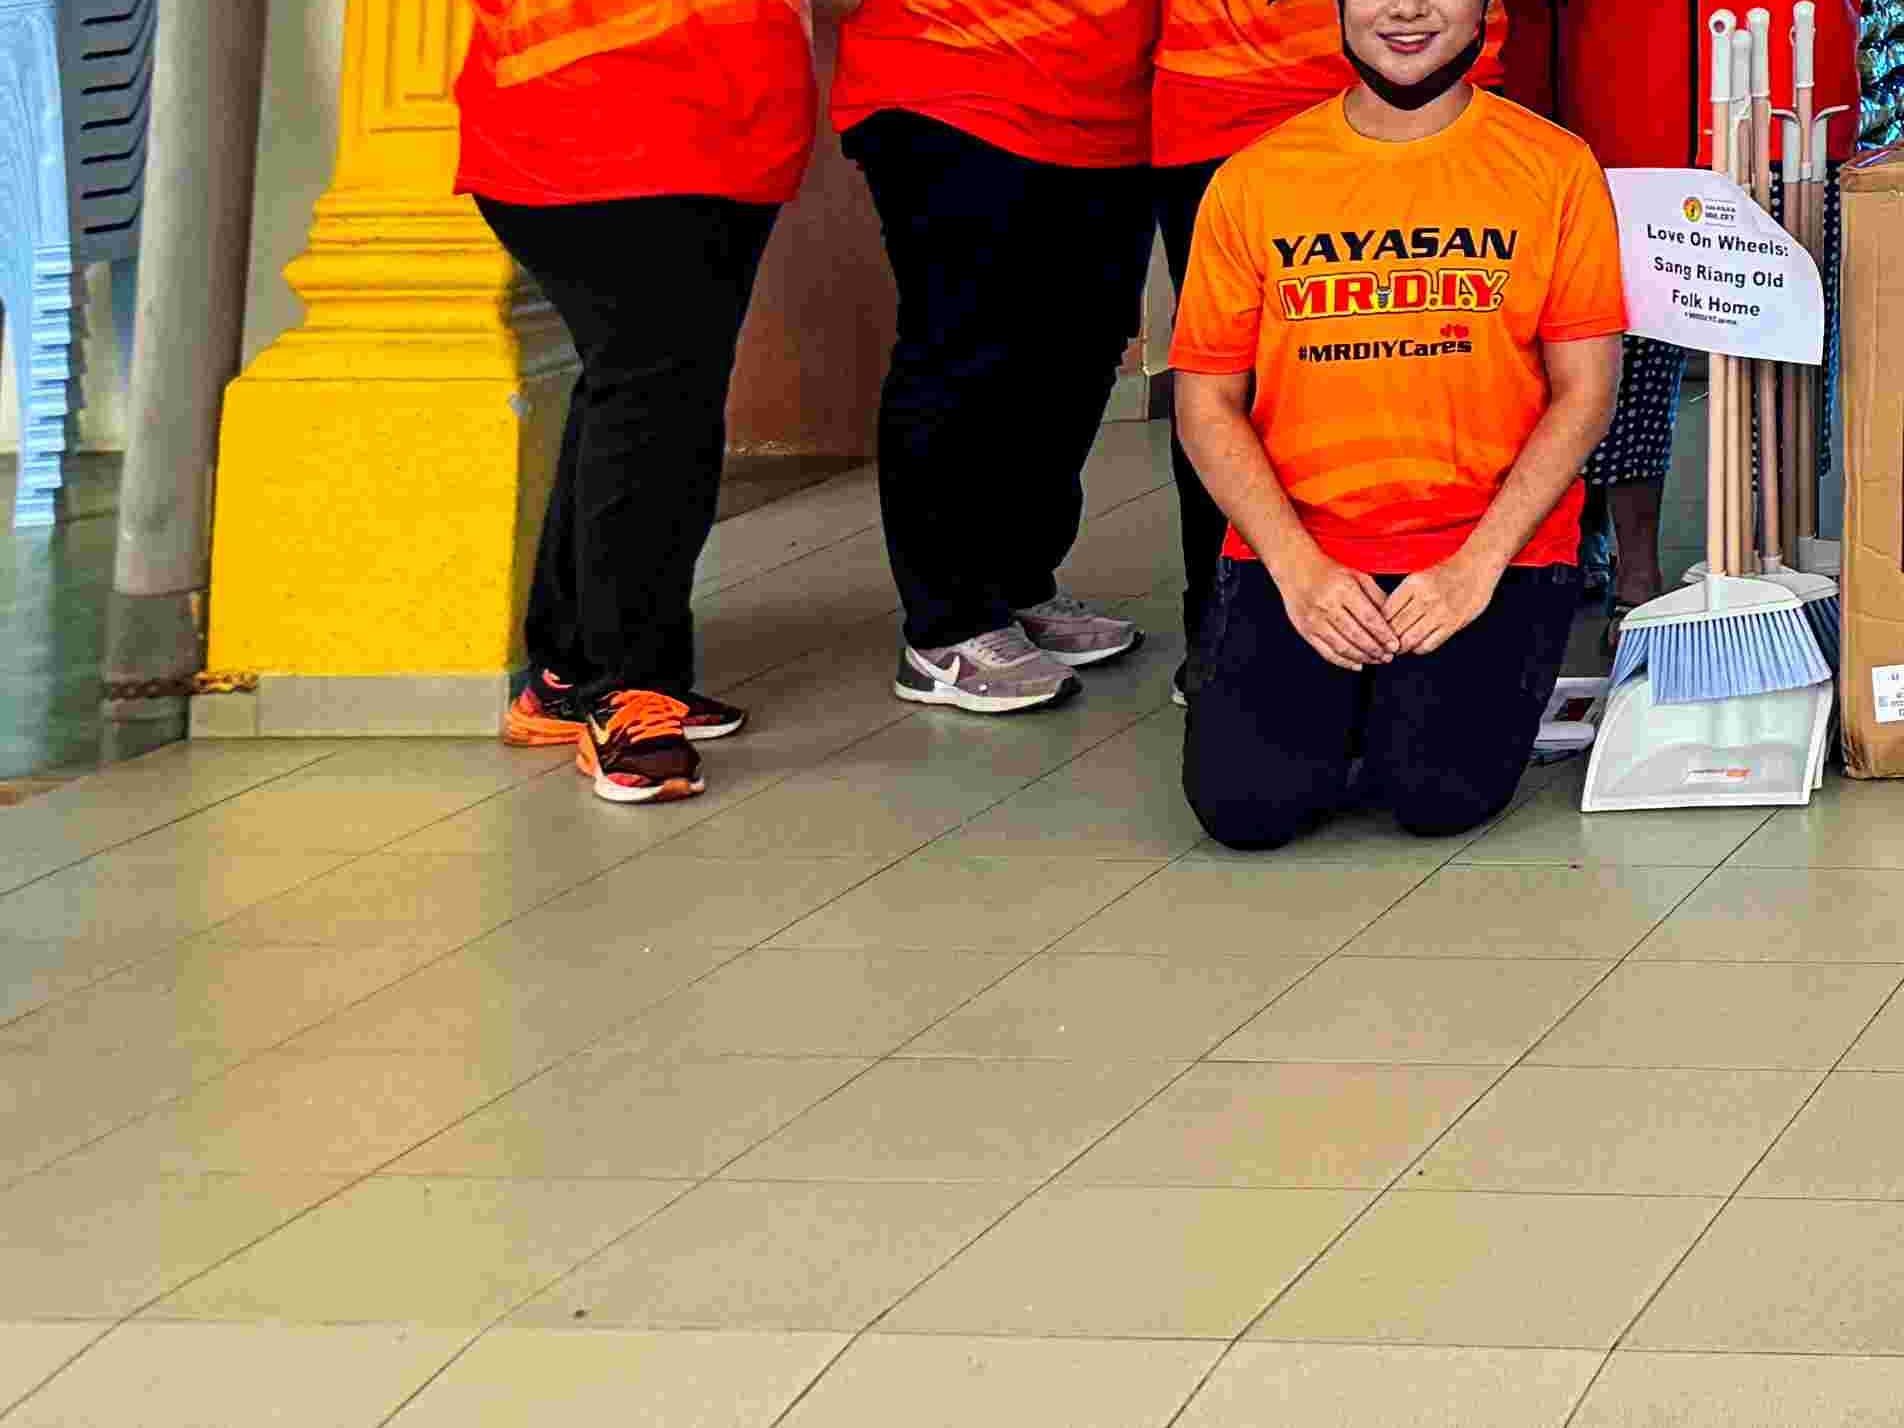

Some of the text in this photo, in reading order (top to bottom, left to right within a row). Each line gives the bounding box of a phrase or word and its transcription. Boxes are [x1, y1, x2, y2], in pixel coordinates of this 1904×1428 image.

[1273, 227, 1517, 268] YAYASAN
[1647, 224, 1789, 257] Love On Wheels:
[1654, 256, 1784, 288] Sang Riang Old
[1672, 289, 1761, 317] Folk Home
[1298, 338, 1472, 362] #MRDIYCares
